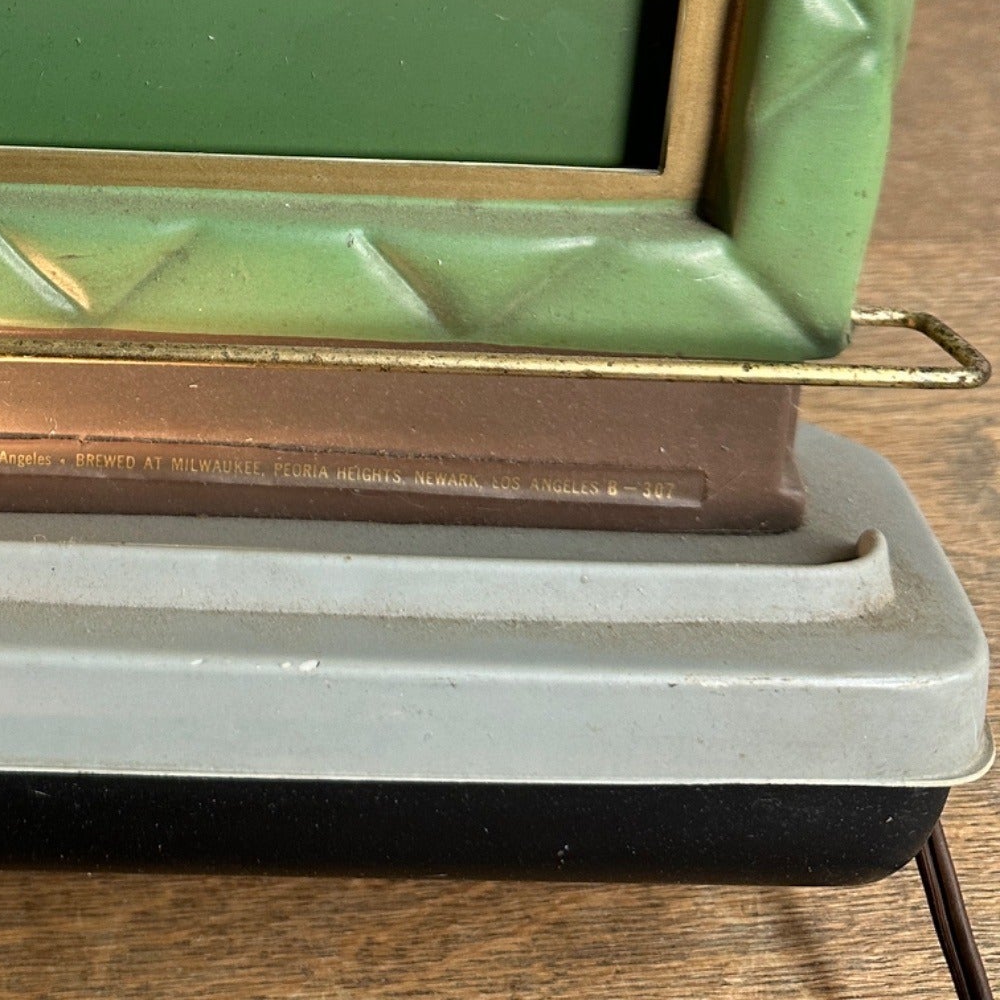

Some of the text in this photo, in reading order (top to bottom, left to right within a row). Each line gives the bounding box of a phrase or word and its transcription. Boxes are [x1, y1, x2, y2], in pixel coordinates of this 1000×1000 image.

[0, 450, 51, 468] Angeles
[76, 453, 136, 470] BREWED
[143, 456, 163, 471] AT
[171, 457, 265, 477] MILWAUKEE,
[274, 463, 329, 480] PEORIA
[414, 470, 484, 490] NEWARK,
[492, 474, 522, 491] LOS
[529, 476, 600, 496] ANGELES
